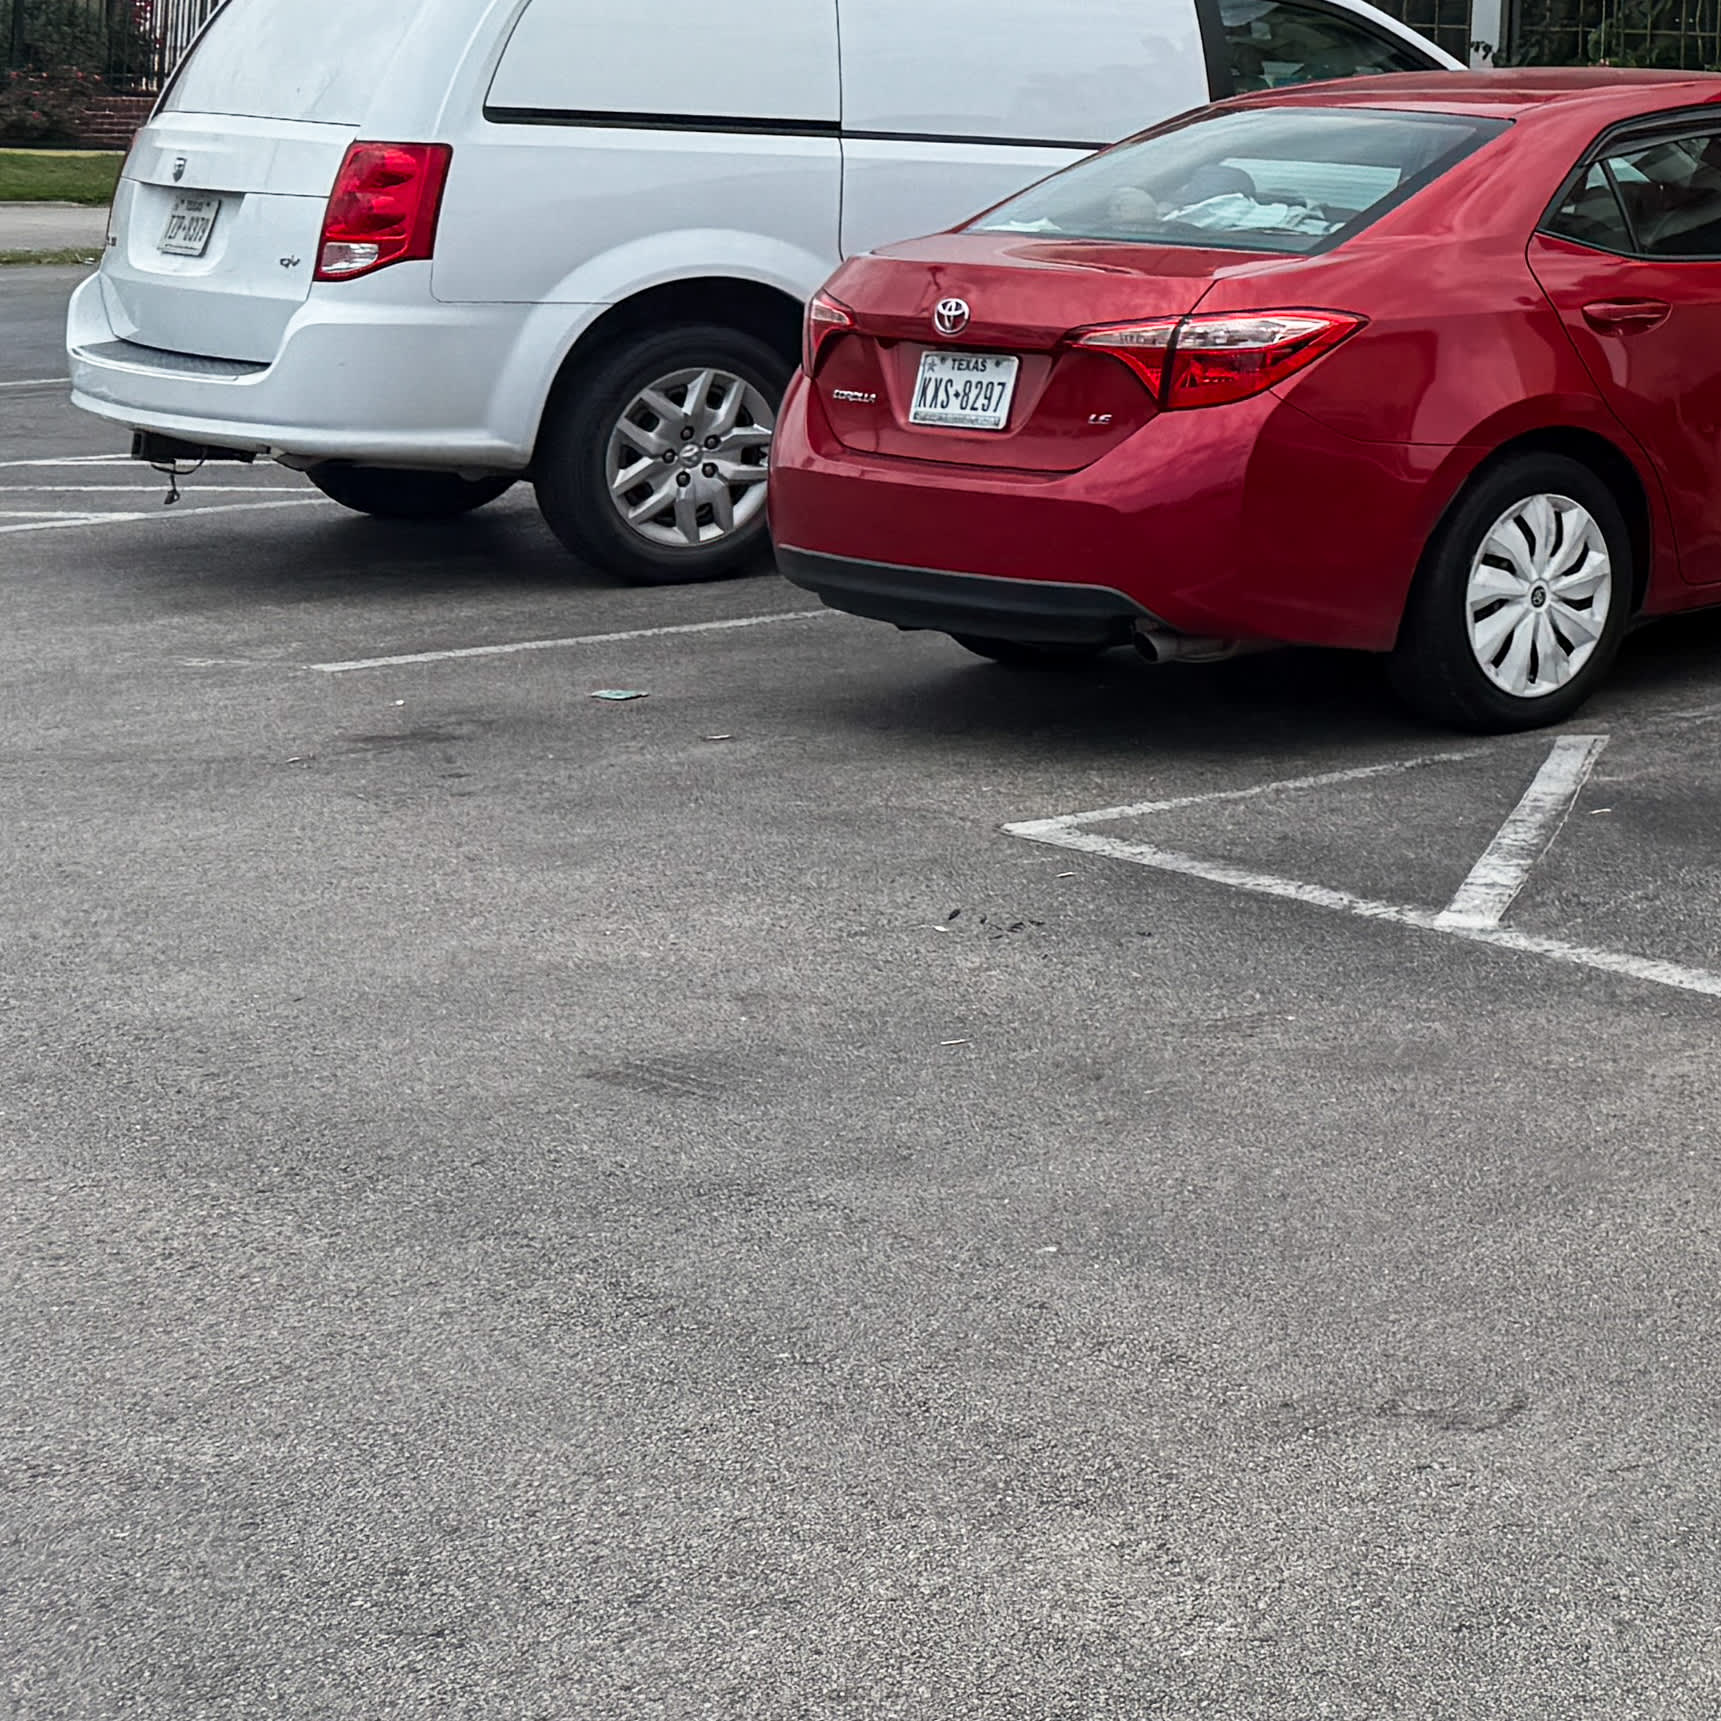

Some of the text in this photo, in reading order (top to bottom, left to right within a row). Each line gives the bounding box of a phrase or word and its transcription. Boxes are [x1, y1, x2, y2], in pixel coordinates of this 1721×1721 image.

[950, 357, 987, 373] TEXAS
[918, 376, 1006, 413] KXS 8297
